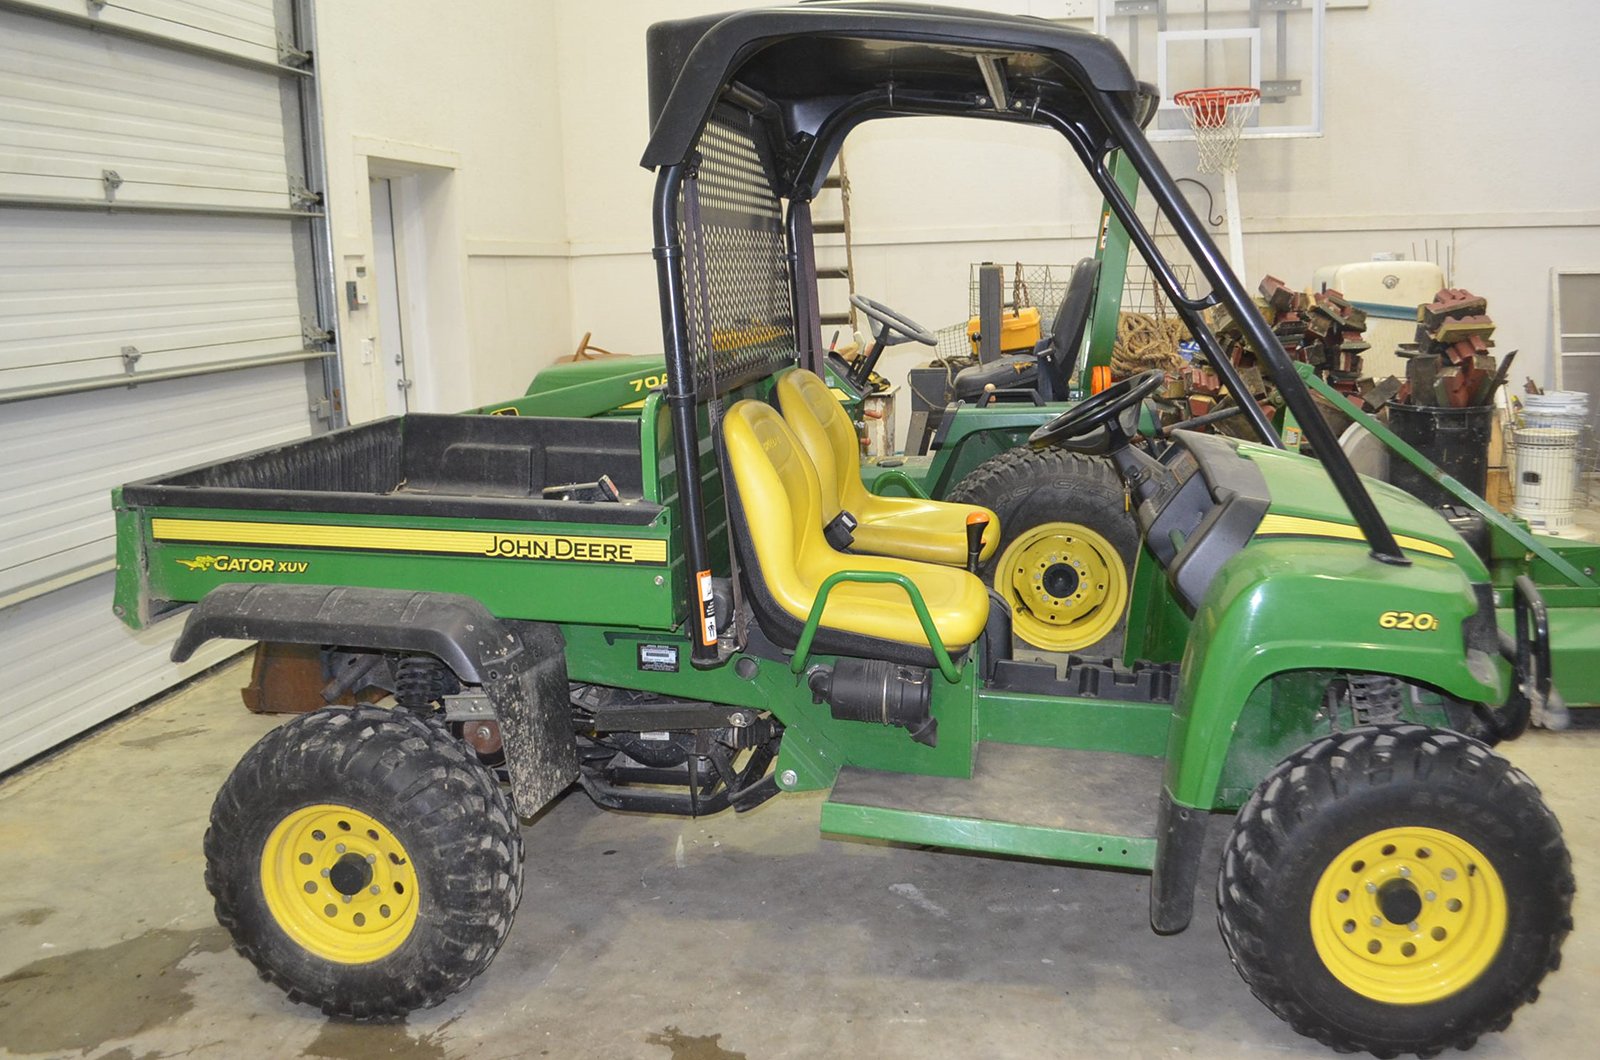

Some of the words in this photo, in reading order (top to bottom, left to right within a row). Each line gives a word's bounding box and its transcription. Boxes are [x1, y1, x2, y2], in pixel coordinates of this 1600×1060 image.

[485, 535, 549, 556] JOHN
[555, 538, 633, 560] DEERE
[214, 555, 276, 573] GATOR
[277, 561, 309, 573] XUV
